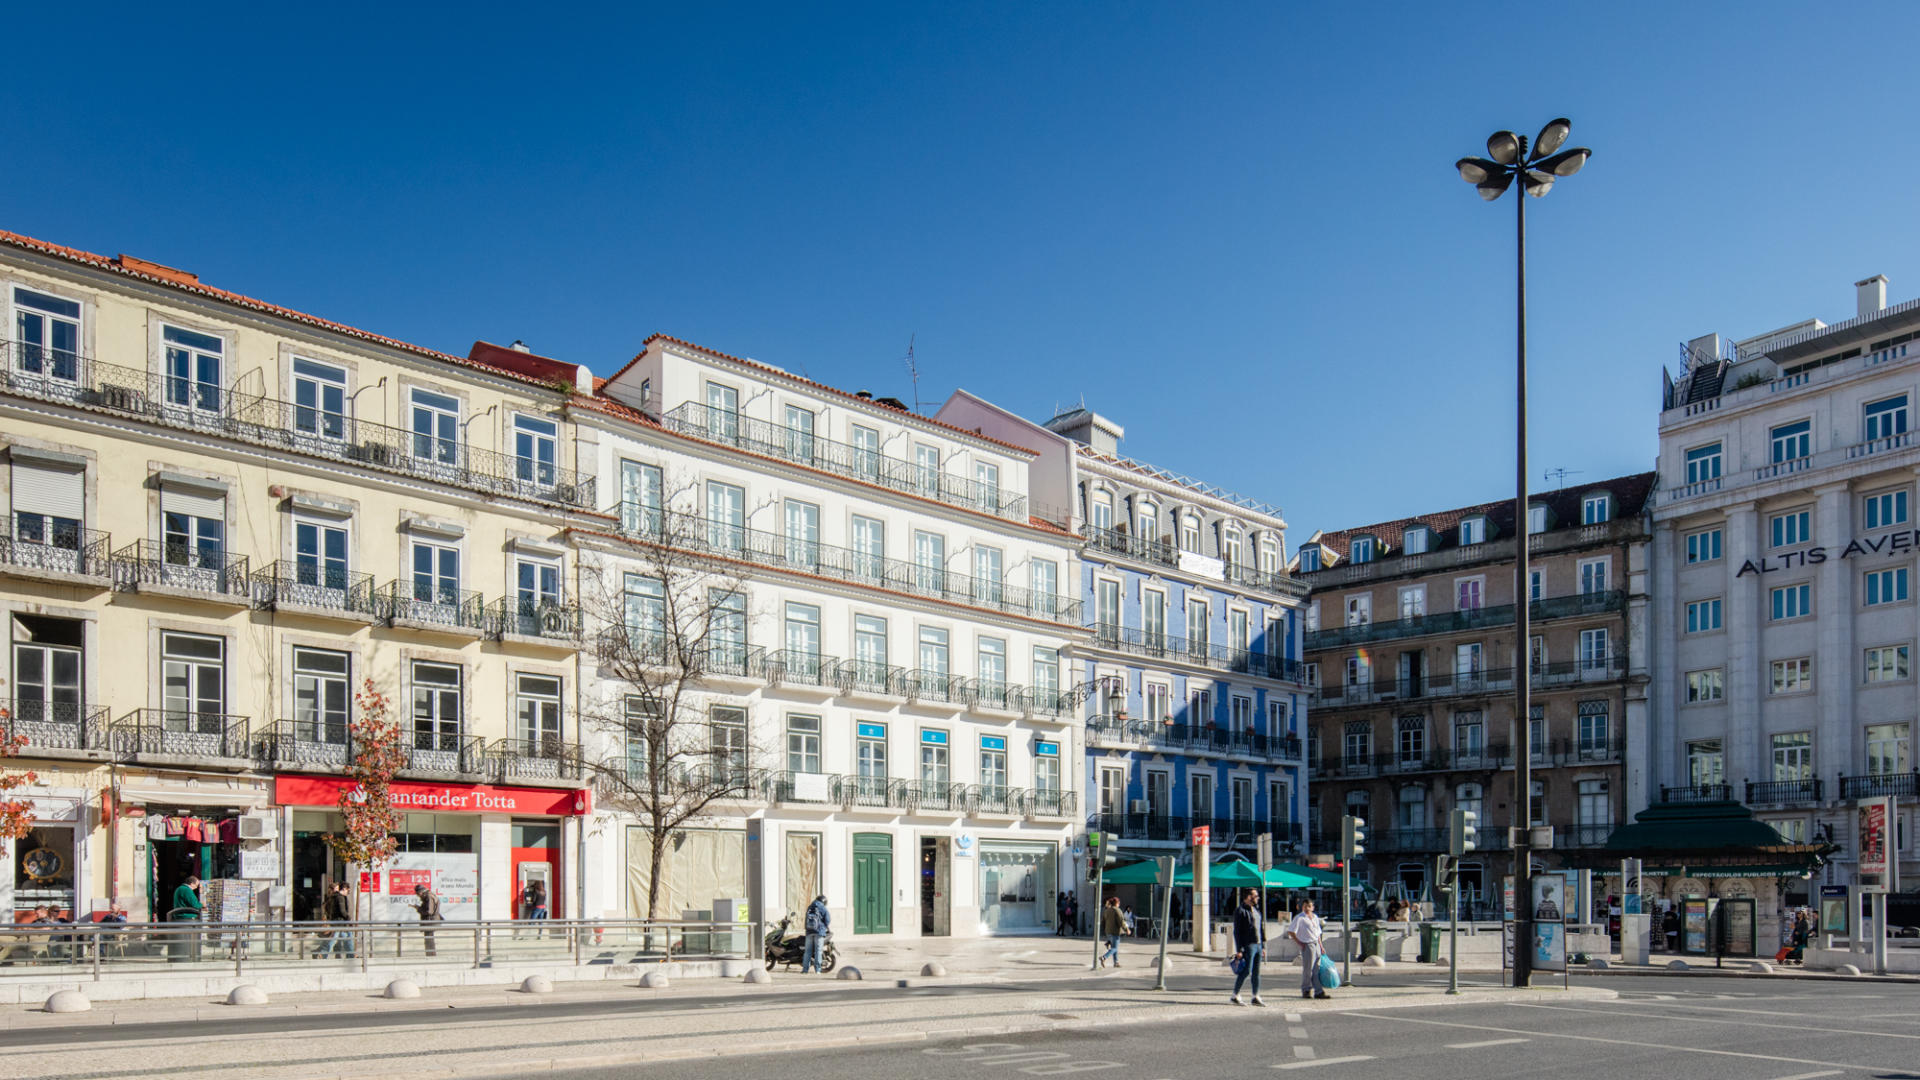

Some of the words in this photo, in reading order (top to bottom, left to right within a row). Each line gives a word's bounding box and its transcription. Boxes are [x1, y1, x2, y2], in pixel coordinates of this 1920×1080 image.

[1736, 547, 1827, 578] ALTIS
[385, 789, 468, 807] antander
[472, 791, 516, 808] Totta
